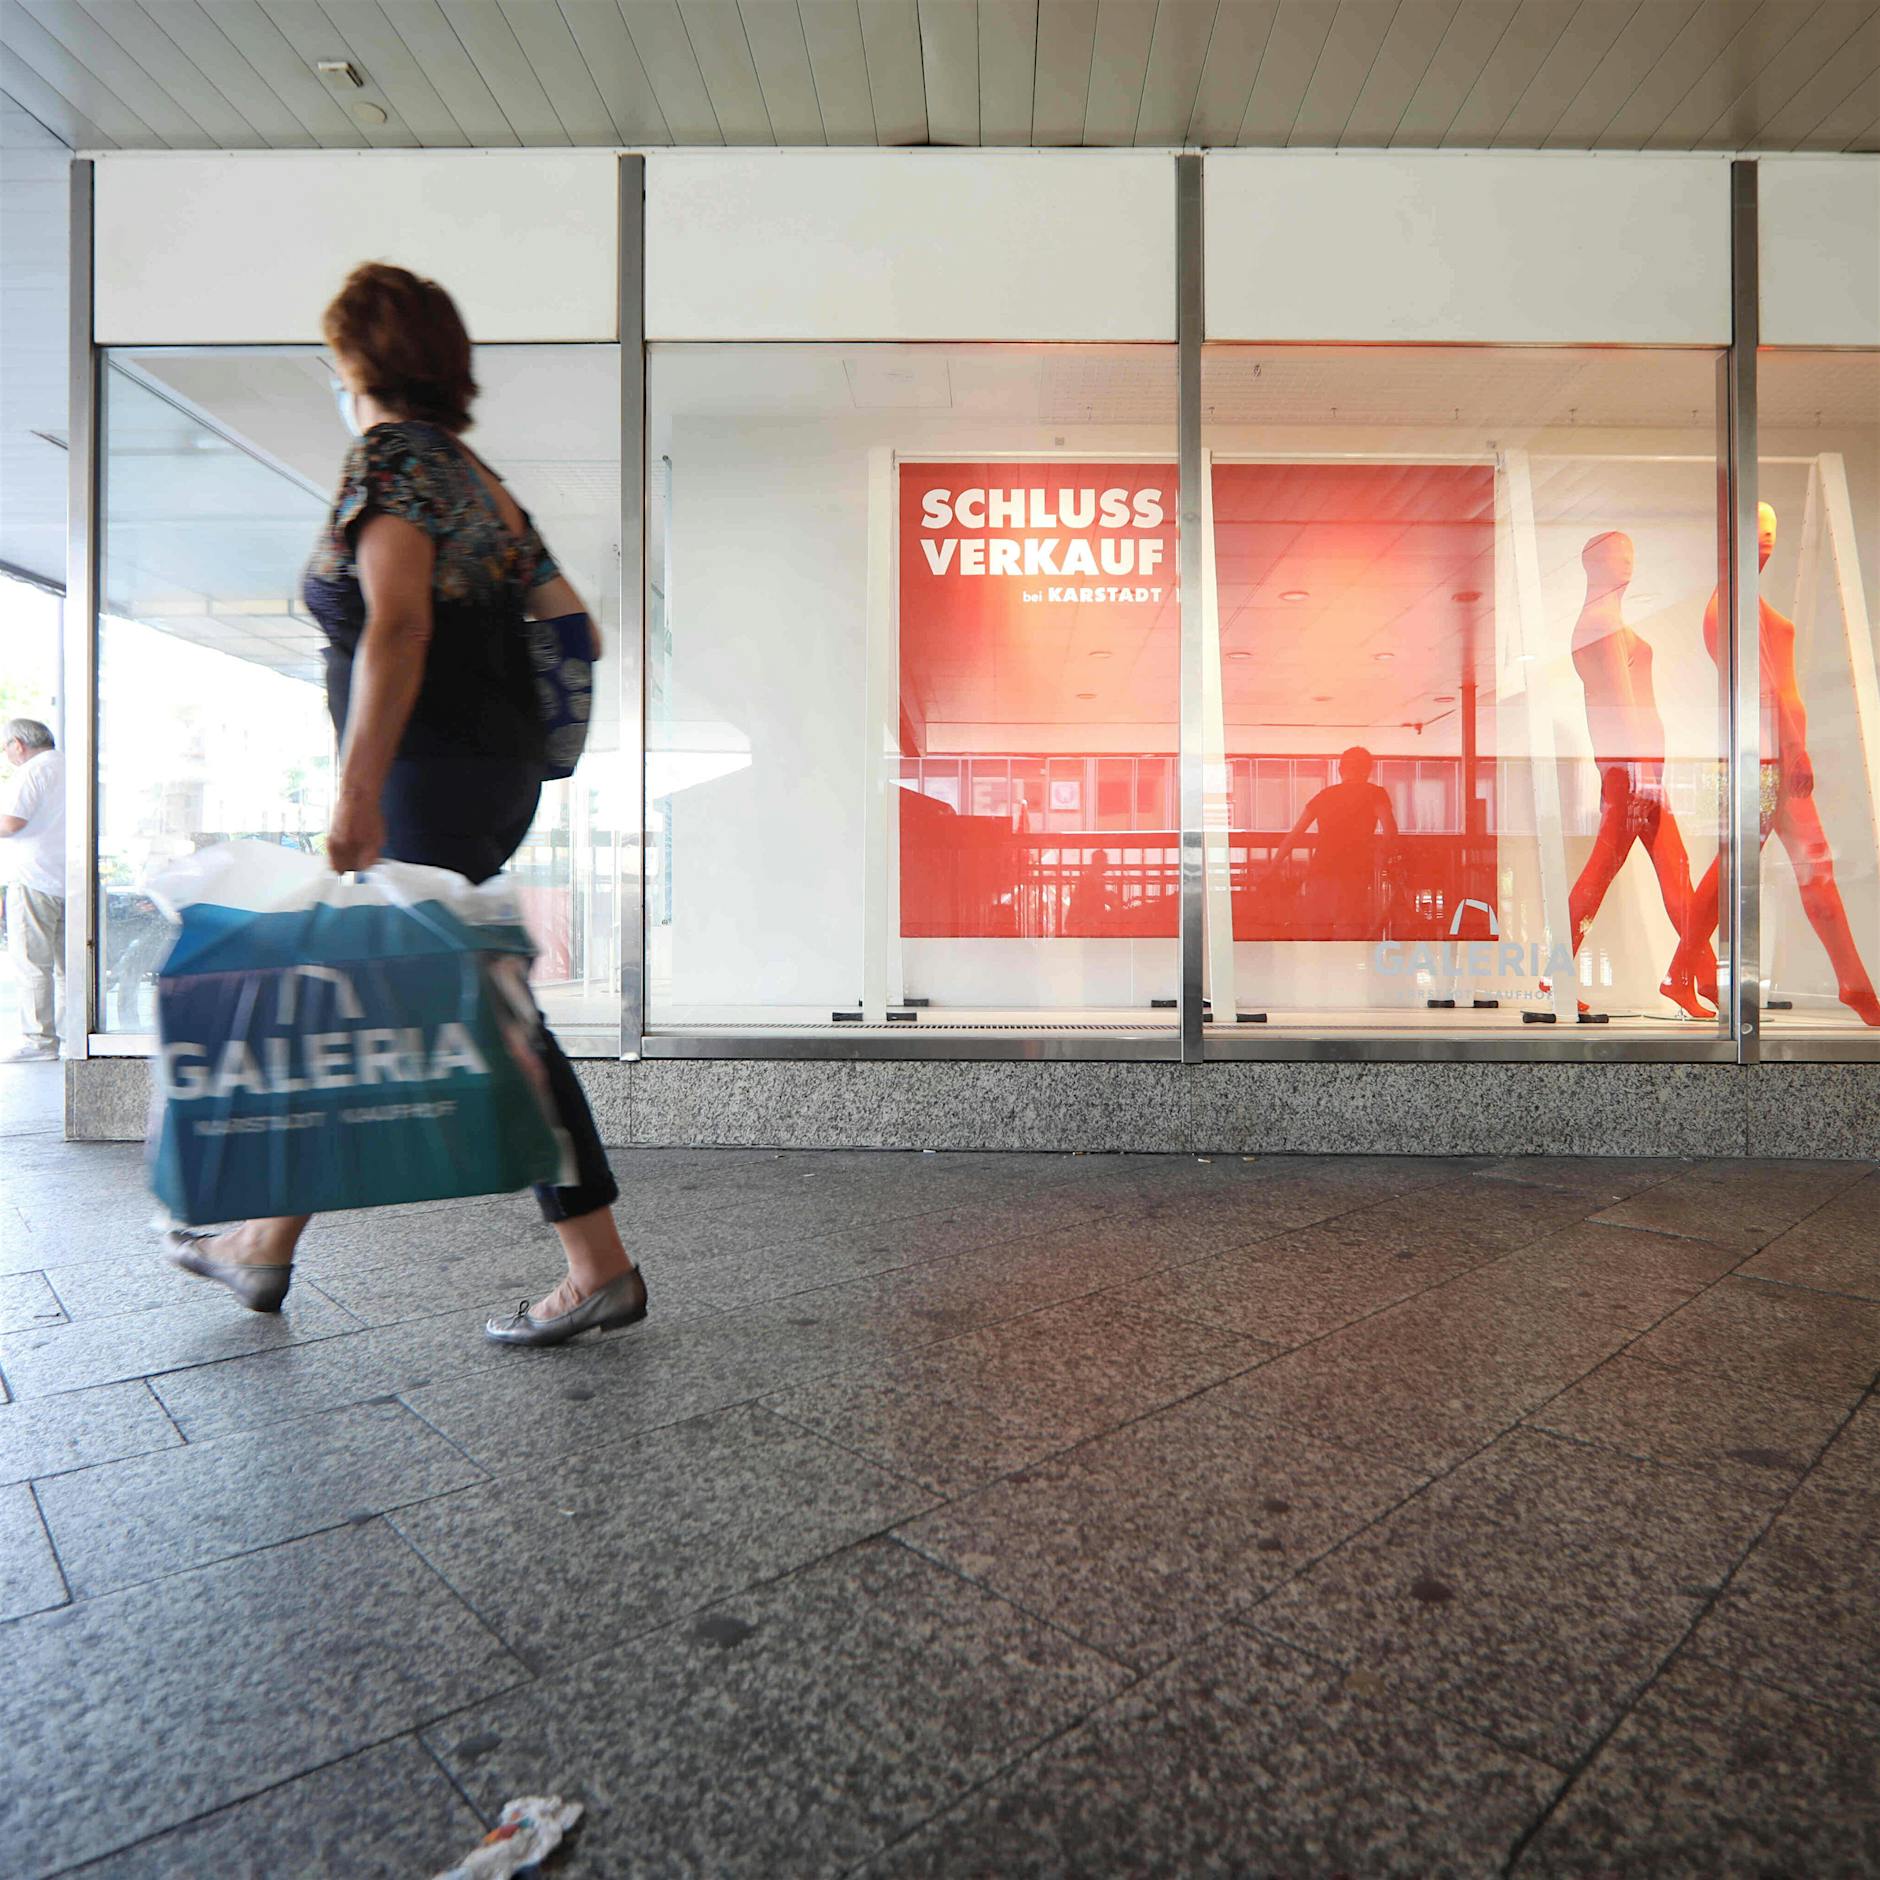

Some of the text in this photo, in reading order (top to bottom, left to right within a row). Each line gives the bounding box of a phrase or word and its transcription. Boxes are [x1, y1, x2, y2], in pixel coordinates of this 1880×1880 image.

[921, 488, 1164, 529] SCHLUSS
[920, 538, 1164, 576] VERKAUF
[1023, 587, 1162, 602] bei KARSTADT
[1375, 941, 1577, 977] GALERIA
[162, 1022, 491, 1100] GALERIA
